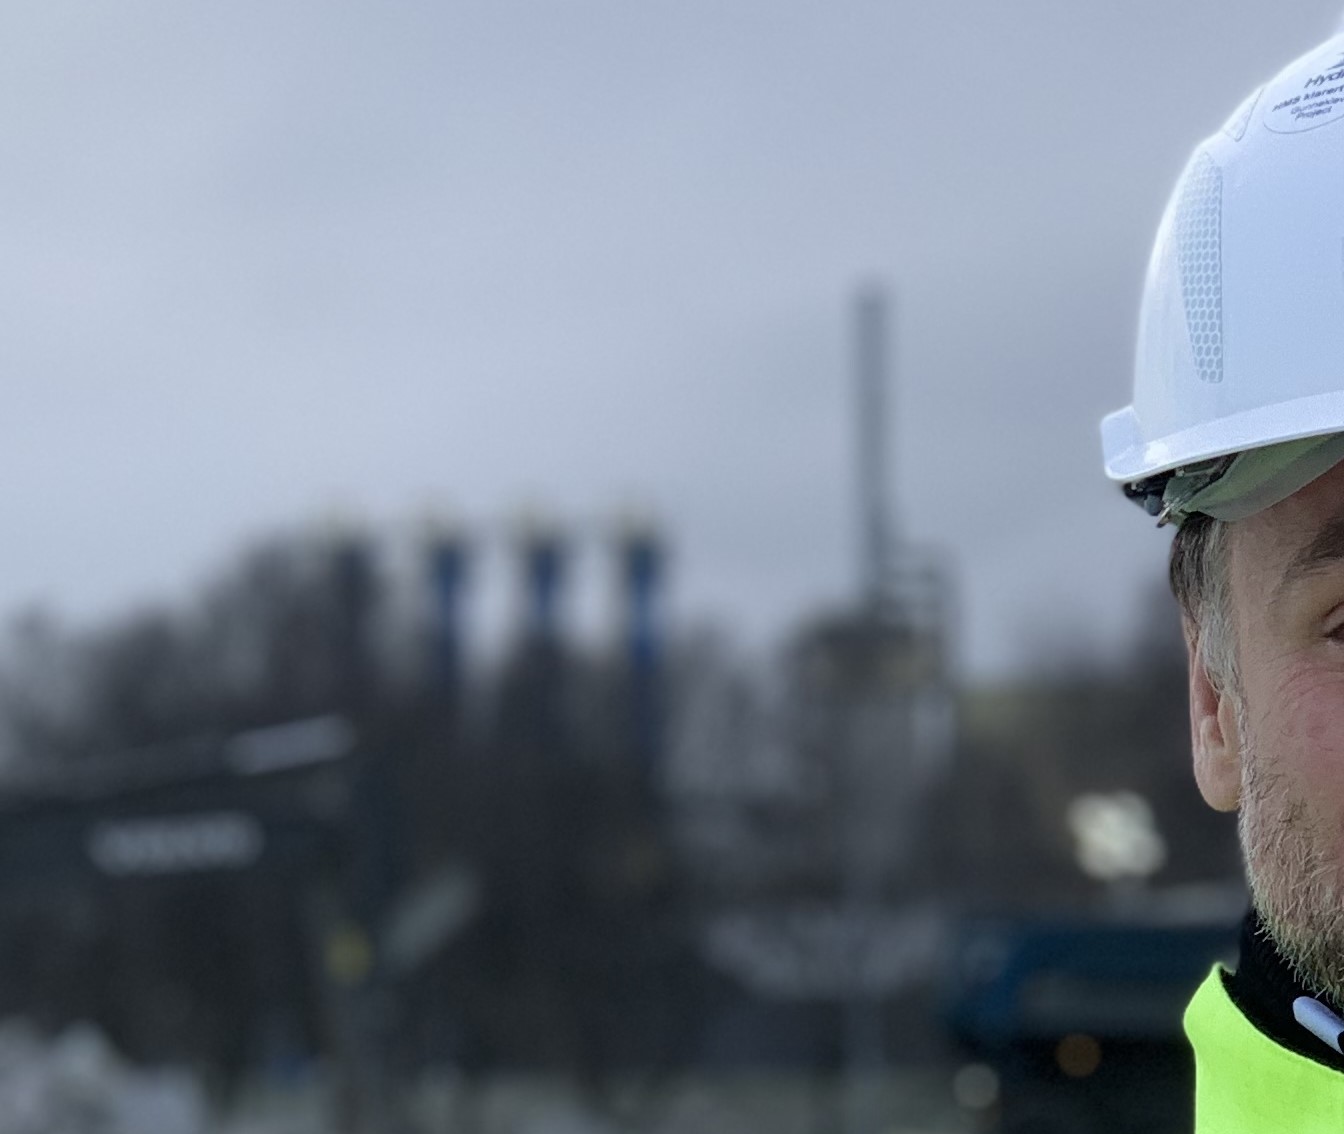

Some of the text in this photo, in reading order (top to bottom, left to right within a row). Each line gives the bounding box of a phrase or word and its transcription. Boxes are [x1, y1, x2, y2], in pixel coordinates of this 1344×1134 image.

[1272, 95, 1301, 112] HMS
[1303, 84, 1344, 101] klarert
[1294, 106, 1333, 121] Project
